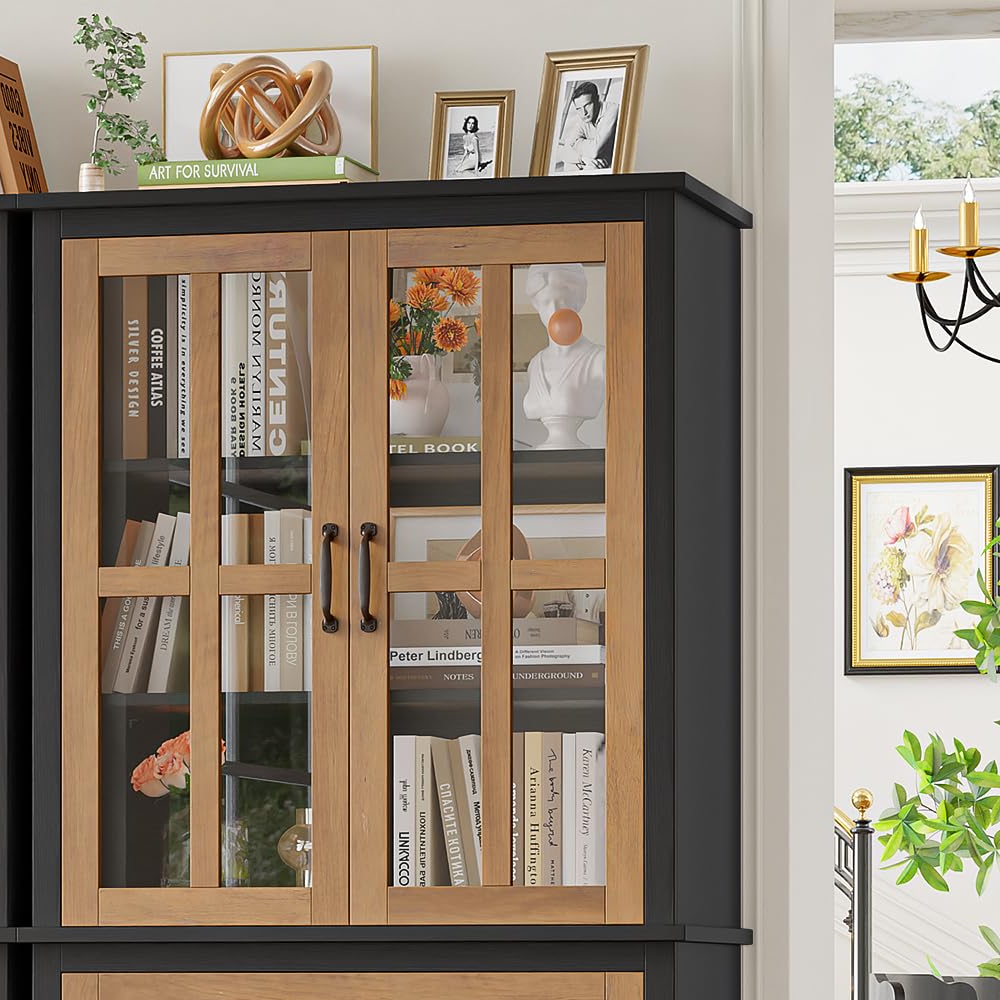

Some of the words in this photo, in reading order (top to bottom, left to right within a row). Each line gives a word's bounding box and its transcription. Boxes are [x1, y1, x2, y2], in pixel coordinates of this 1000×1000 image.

[149, 164, 171, 180] ART
[176, 164, 200, 178] FOR
[204, 162, 259, 178] SURVIVAL
[180, 279, 188, 331] simplicity
[128, 320, 139, 364] SILVER
[150, 328, 164, 369] COFFEE
[180, 334, 188, 343] is
[180, 347, 188, 356] in
[128, 370, 139, 418] DESIGN
[150, 372, 164, 407] ATLAS
[180, 360, 188, 417] everything
[181, 420, 188, 432] we
[424, 442, 478, 454] BOOK
[135, 618, 144, 630] for
[151, 535, 166, 566] lifestyle
[112, 630, 125, 650] THIS
[117, 621, 126, 630] IS
[159, 618, 173, 651] DREAM
[286, 621, 298, 666] ГОЛОВУ
[390, 650, 424, 662] Peter
[427, 650, 482, 664] Lindberg
[512, 672, 584, 680] UNDERGROUND
[582, 748, 592, 778] Karen
[439, 783, 458, 836] СПАСИТЕ
[530, 767, 540, 817] Arianna
[580, 781, 592, 836] McCartney
[448, 838, 465, 886] КОТИКА
